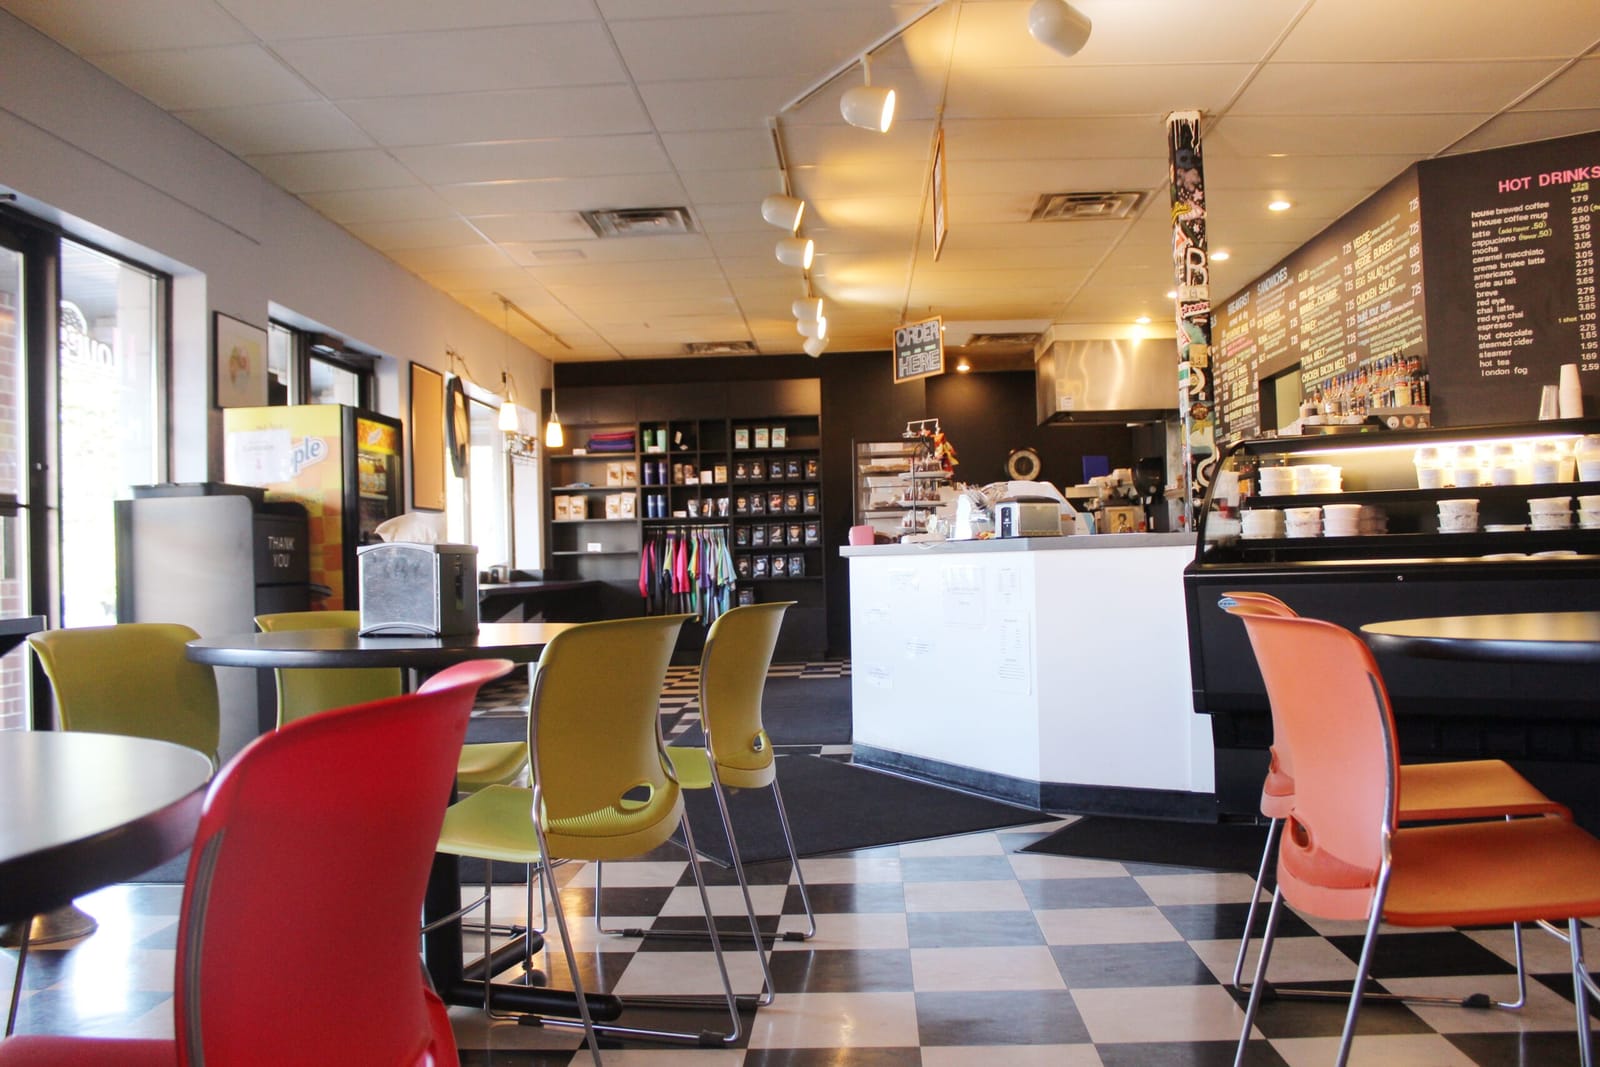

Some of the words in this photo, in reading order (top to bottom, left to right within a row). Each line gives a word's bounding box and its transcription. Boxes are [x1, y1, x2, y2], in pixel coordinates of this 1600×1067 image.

[1498, 176, 1531, 193] HOT
[1539, 165, 1600, 187] DRINKS
[1471, 209, 1495, 219] house
[1495, 204, 1524, 215] brewed
[1524, 201, 1550, 212] coffee
[1478, 217, 1503, 227] house
[1503, 213, 1529, 224] coffee
[1530, 211, 1549, 222] mug
[1472, 230, 1491, 239] latte
[1472, 245, 1499, 256] mocha
[1472, 252, 1503, 264] caramel
[1504, 248, 1545, 260] macchiato
[1473, 263, 1498, 273] creme
[1500, 260, 1526, 270] brulee
[1527, 257, 1546, 266] latte
[1257, 267, 1288, 294] SANDWICHES
[1473, 269, 1514, 281] americano
[1474, 280, 1492, 289] cafe
[1493, 280, 1503, 288] au
[1476, 289, 1499, 298] breve
[1477, 298, 1490, 307] red
[1491, 297, 1506, 307] eye
[1476, 306, 1494, 316] chai
[1496, 304, 1515, 313] latte
[1477, 314, 1491, 323] red
[1491, 313, 1506, 324] eye
[1507, 310, 1524, 319] chai
[1579, 312, 1597, 322] 1.00
[1477, 321, 1513, 333] espresso
[896, 320, 940, 347] ORDER
[1478, 332, 1492, 341] hot
[1495, 328, 1534, 340] chocolate
[1479, 338, 1513, 350] steamed
[1514, 337, 1534, 347] cider
[1479, 349, 1513, 359] steamer
[898, 349, 940, 378] HERE
[1479, 359, 1493, 369] hot
[1497, 359, 1510, 367] tea
[1581, 363, 1599, 372] 2.59
[1513, 366, 1529, 376] fog
[268, 536, 295, 551] THANK
[272, 554, 290, 568] YOU
